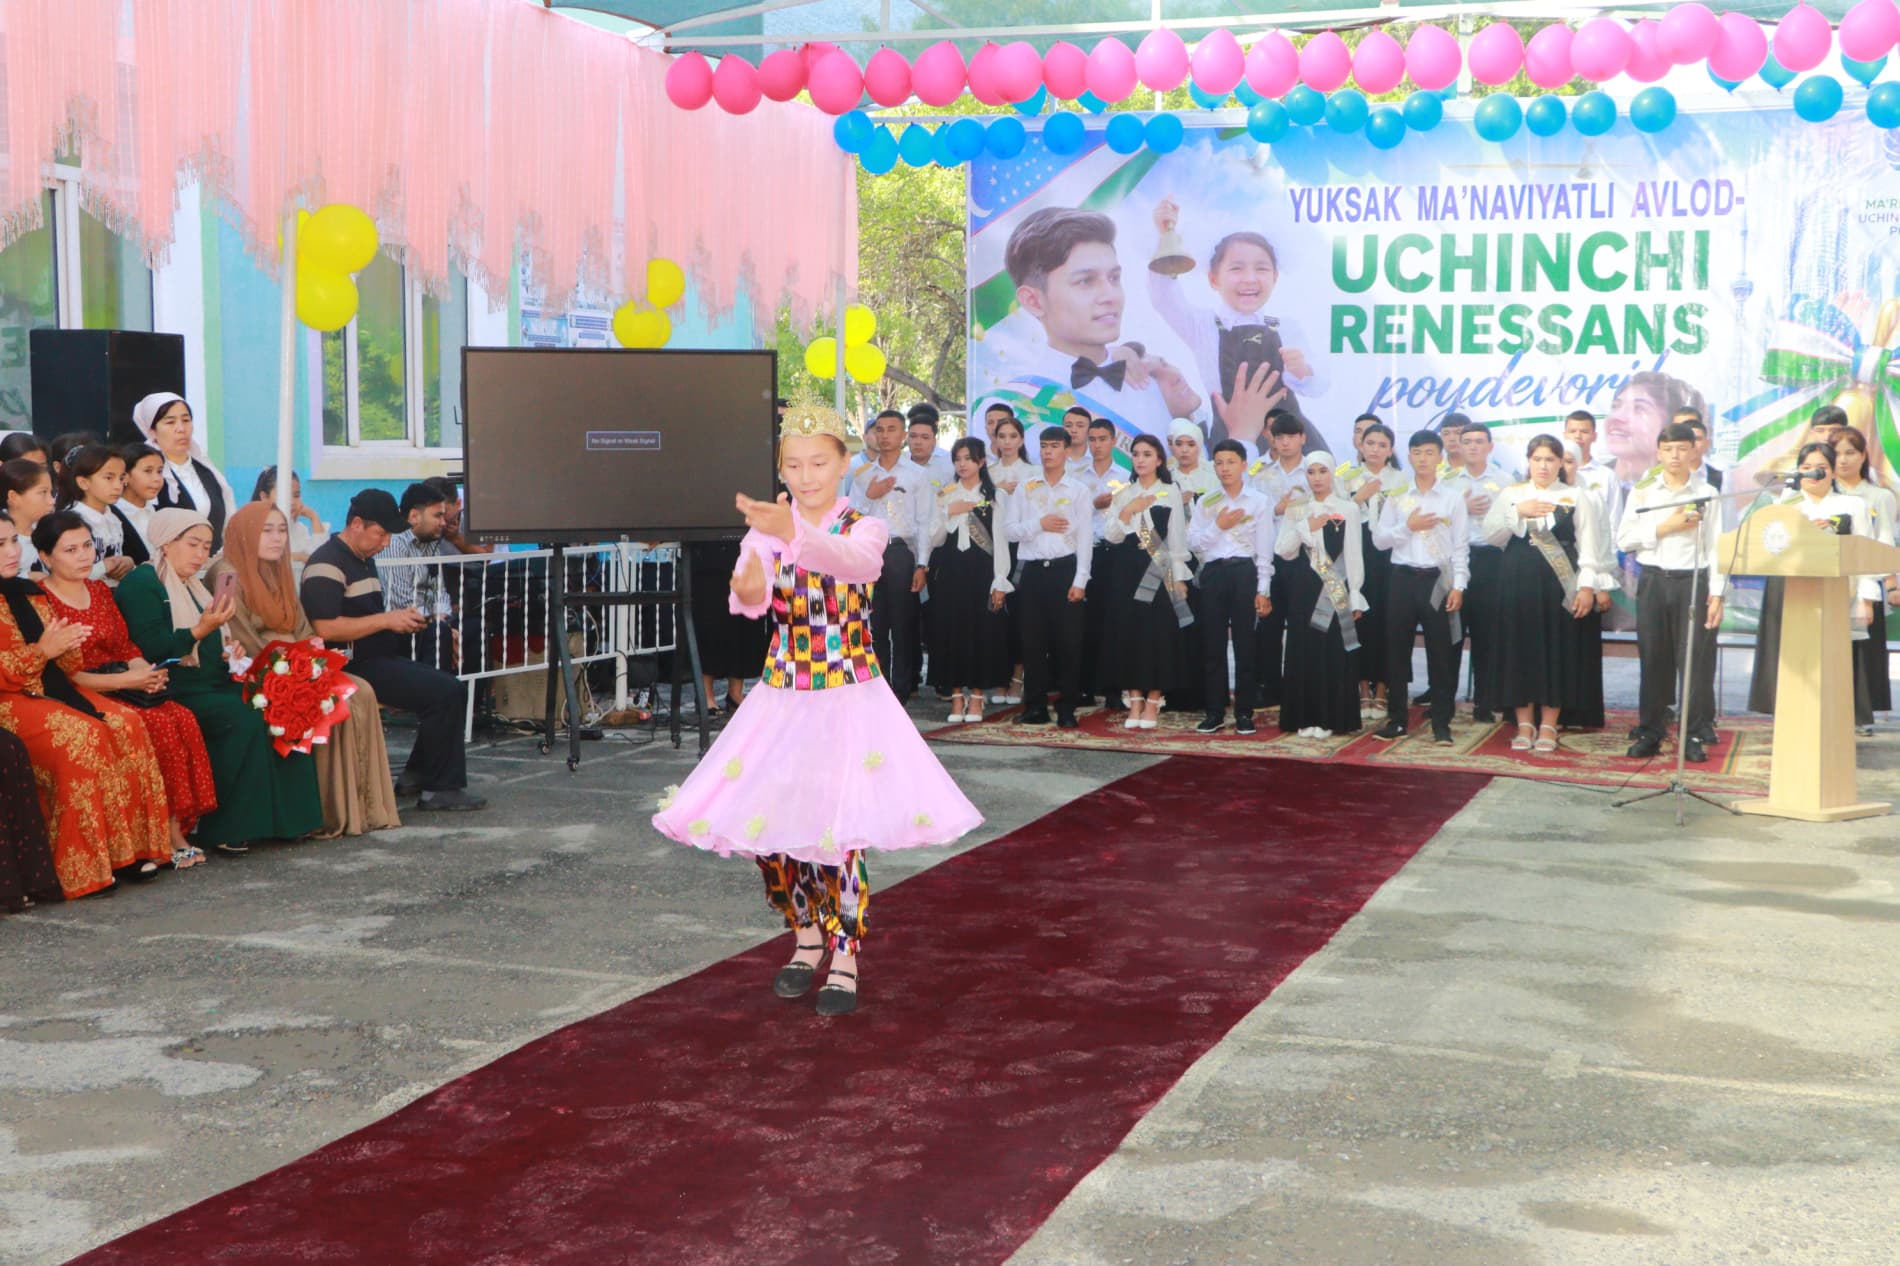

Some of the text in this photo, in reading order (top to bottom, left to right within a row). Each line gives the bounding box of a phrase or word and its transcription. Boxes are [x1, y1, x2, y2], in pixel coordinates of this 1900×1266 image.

[1290, 186, 1402, 223] YUKSAK
[1631, 178, 1745, 218] AVLOD-
[1331, 229, 1711, 293] UCHINCHI
[1330, 302, 1710, 355] RENESSANS
